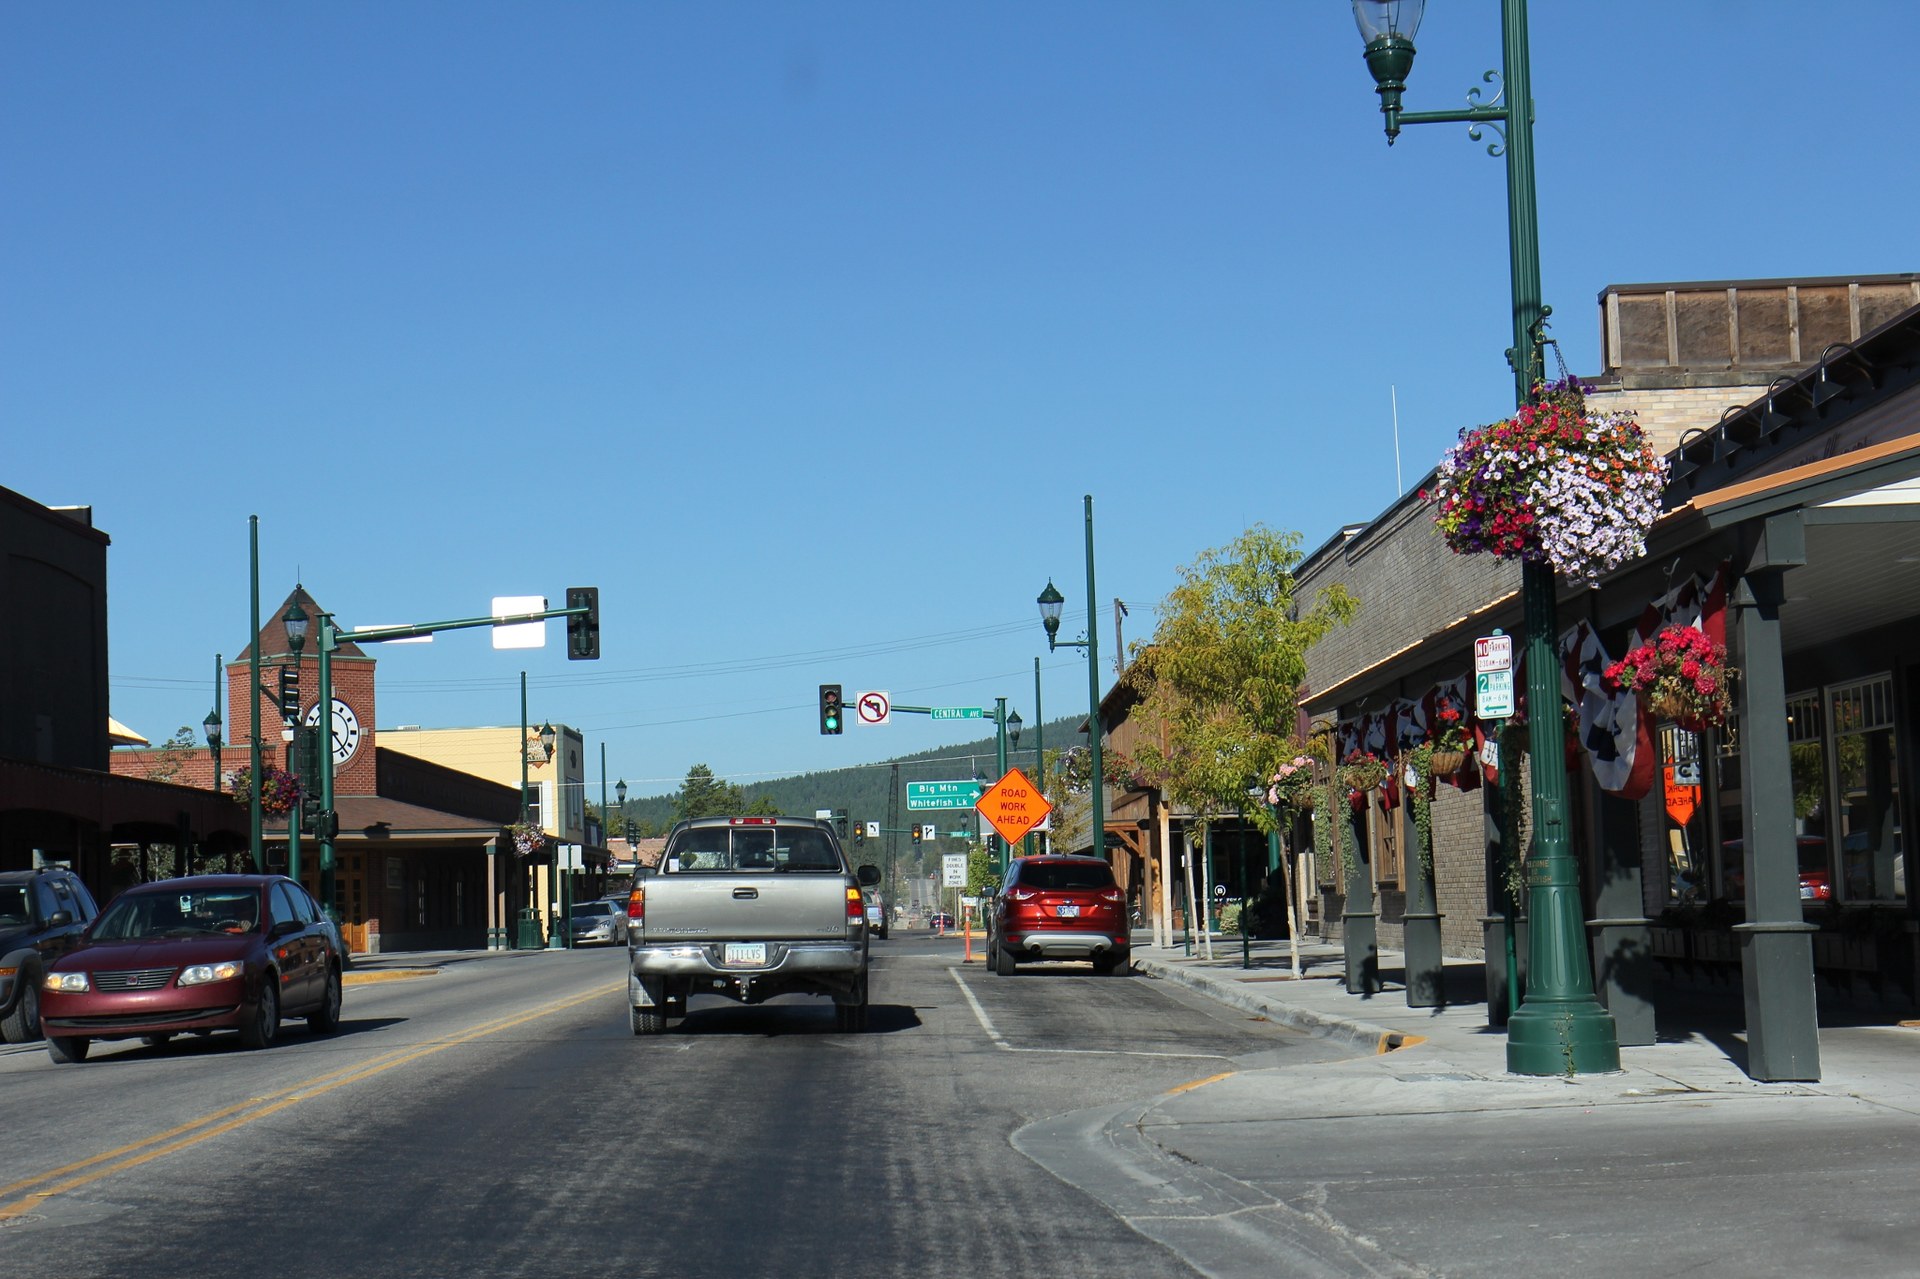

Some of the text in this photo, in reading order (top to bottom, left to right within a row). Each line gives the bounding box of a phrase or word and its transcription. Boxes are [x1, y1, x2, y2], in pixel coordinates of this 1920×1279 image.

[1477, 642, 1509, 657] NO PARKING
[1495, 674, 1505, 683] HR
[1480, 675, 1511, 693] 2 PARKING
[934, 709, 980, 719] CENTRAL AVE
[919, 784, 958, 793] Big Mtn
[1001, 788, 1027, 798] ROAD
[910, 799, 953, 808] Whitefish
[1001, 802, 1026, 811] WORK
[997, 815, 1030, 825] AHEAD
